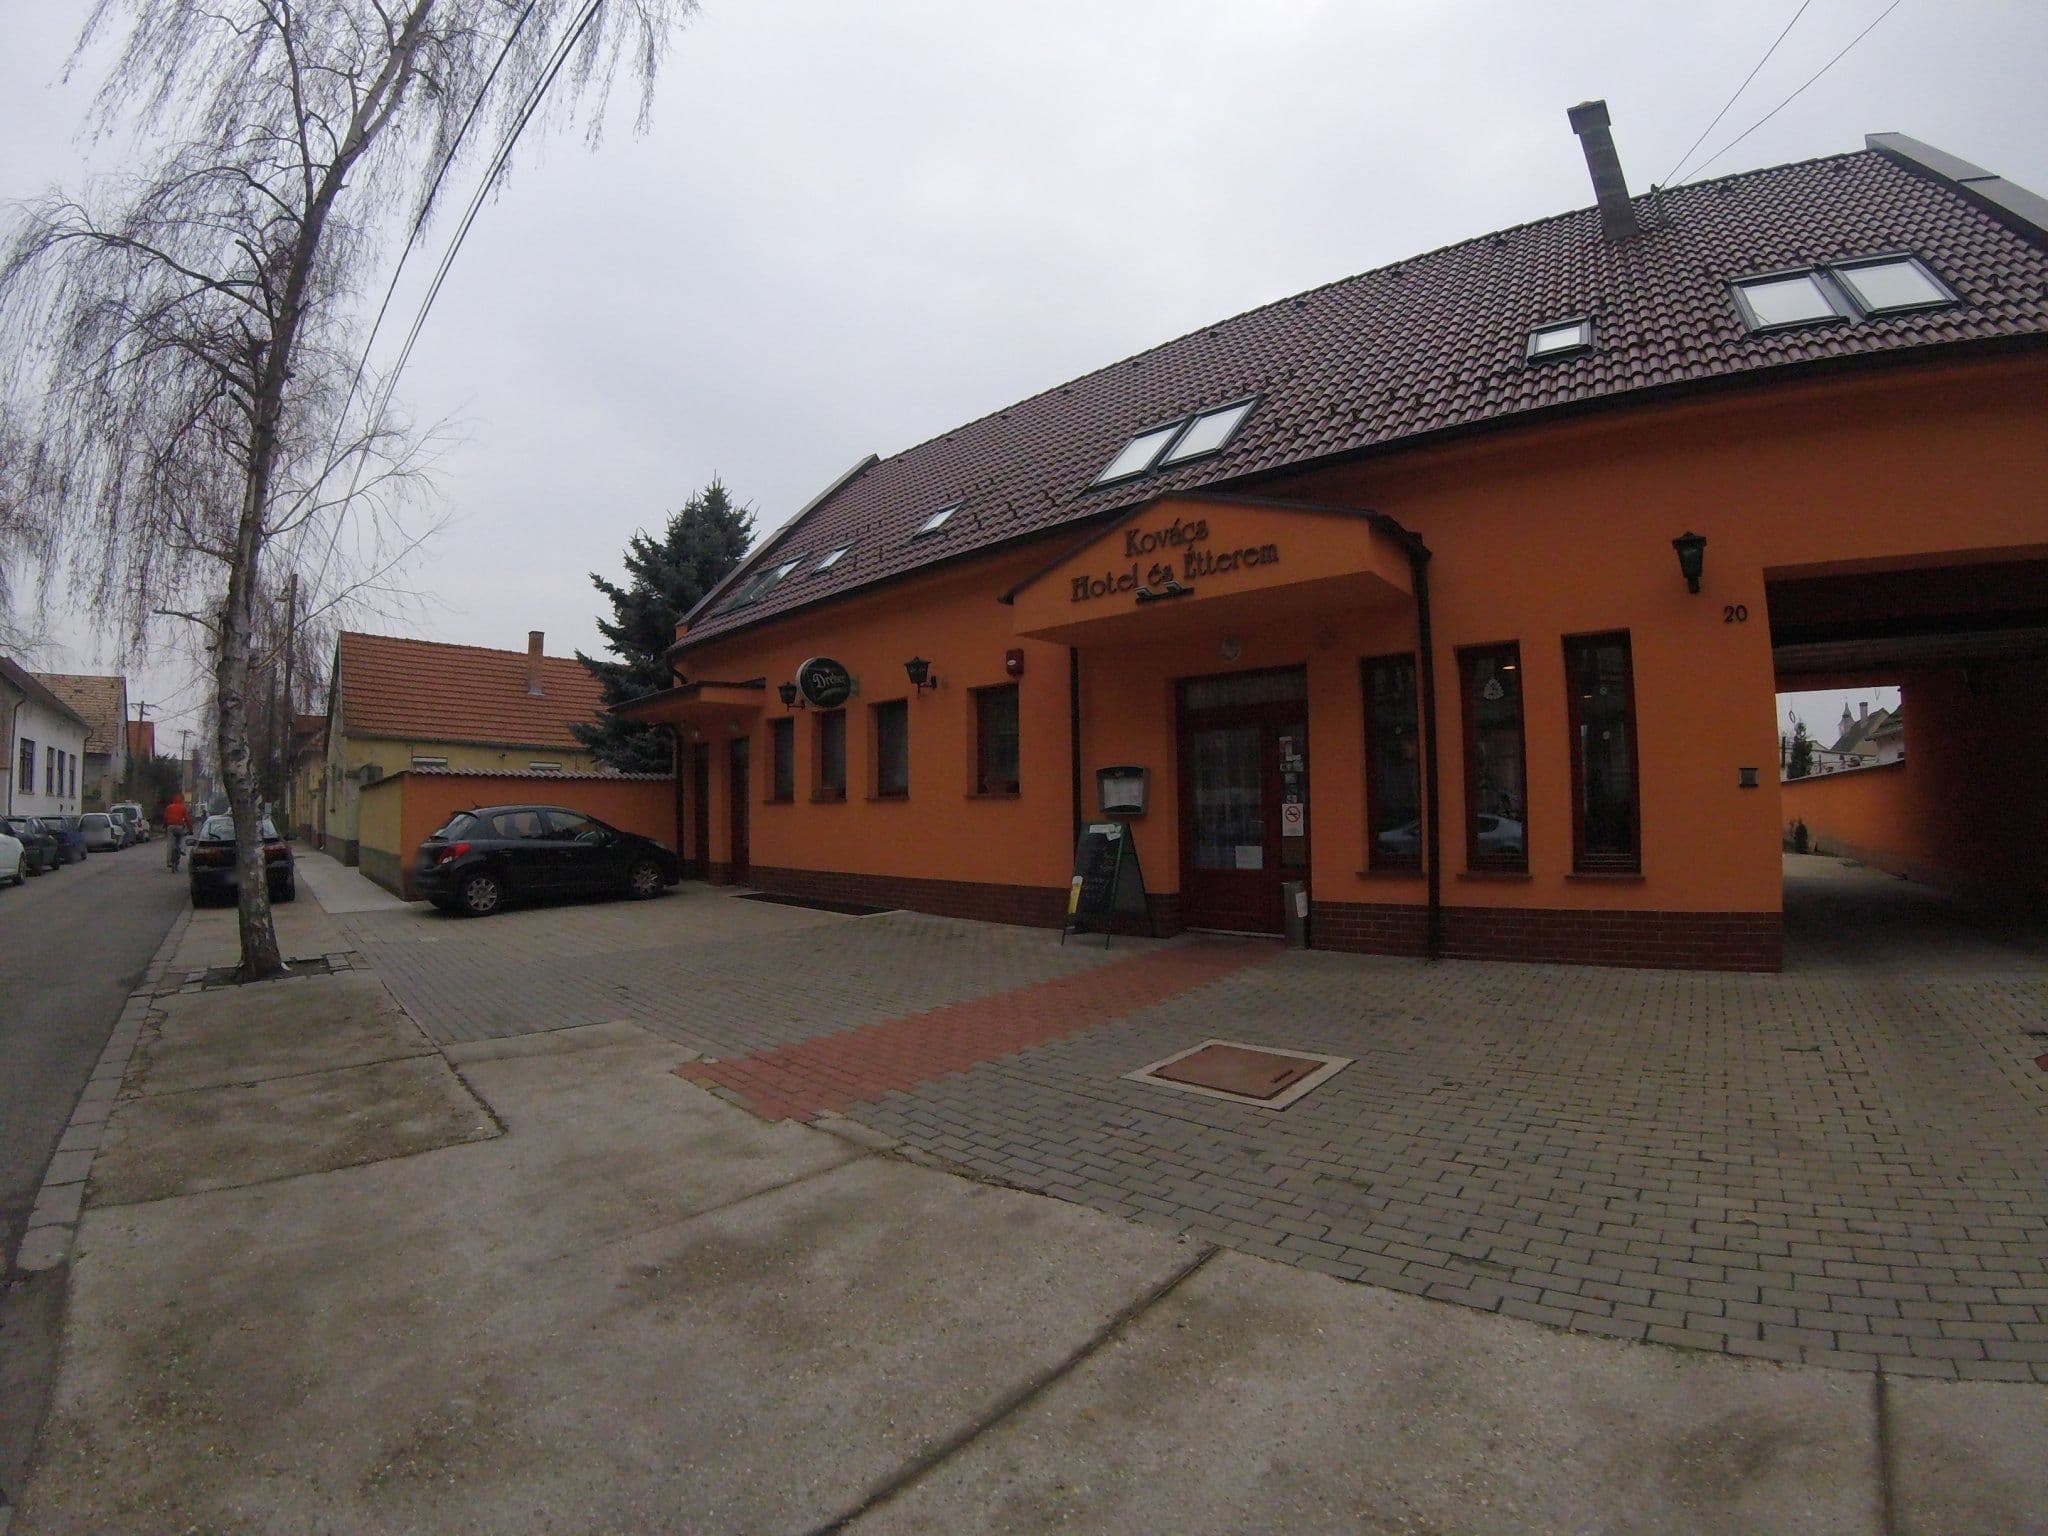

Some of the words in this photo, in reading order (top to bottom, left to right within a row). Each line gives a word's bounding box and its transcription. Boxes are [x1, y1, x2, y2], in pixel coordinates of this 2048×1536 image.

[1125, 518, 1208, 557] Kovács
[1070, 563, 1139, 602] Hotel
[1148, 563, 1174, 585] és
[1183, 544, 1279, 579] Étterem
[1723, 604, 1747, 624] 20
